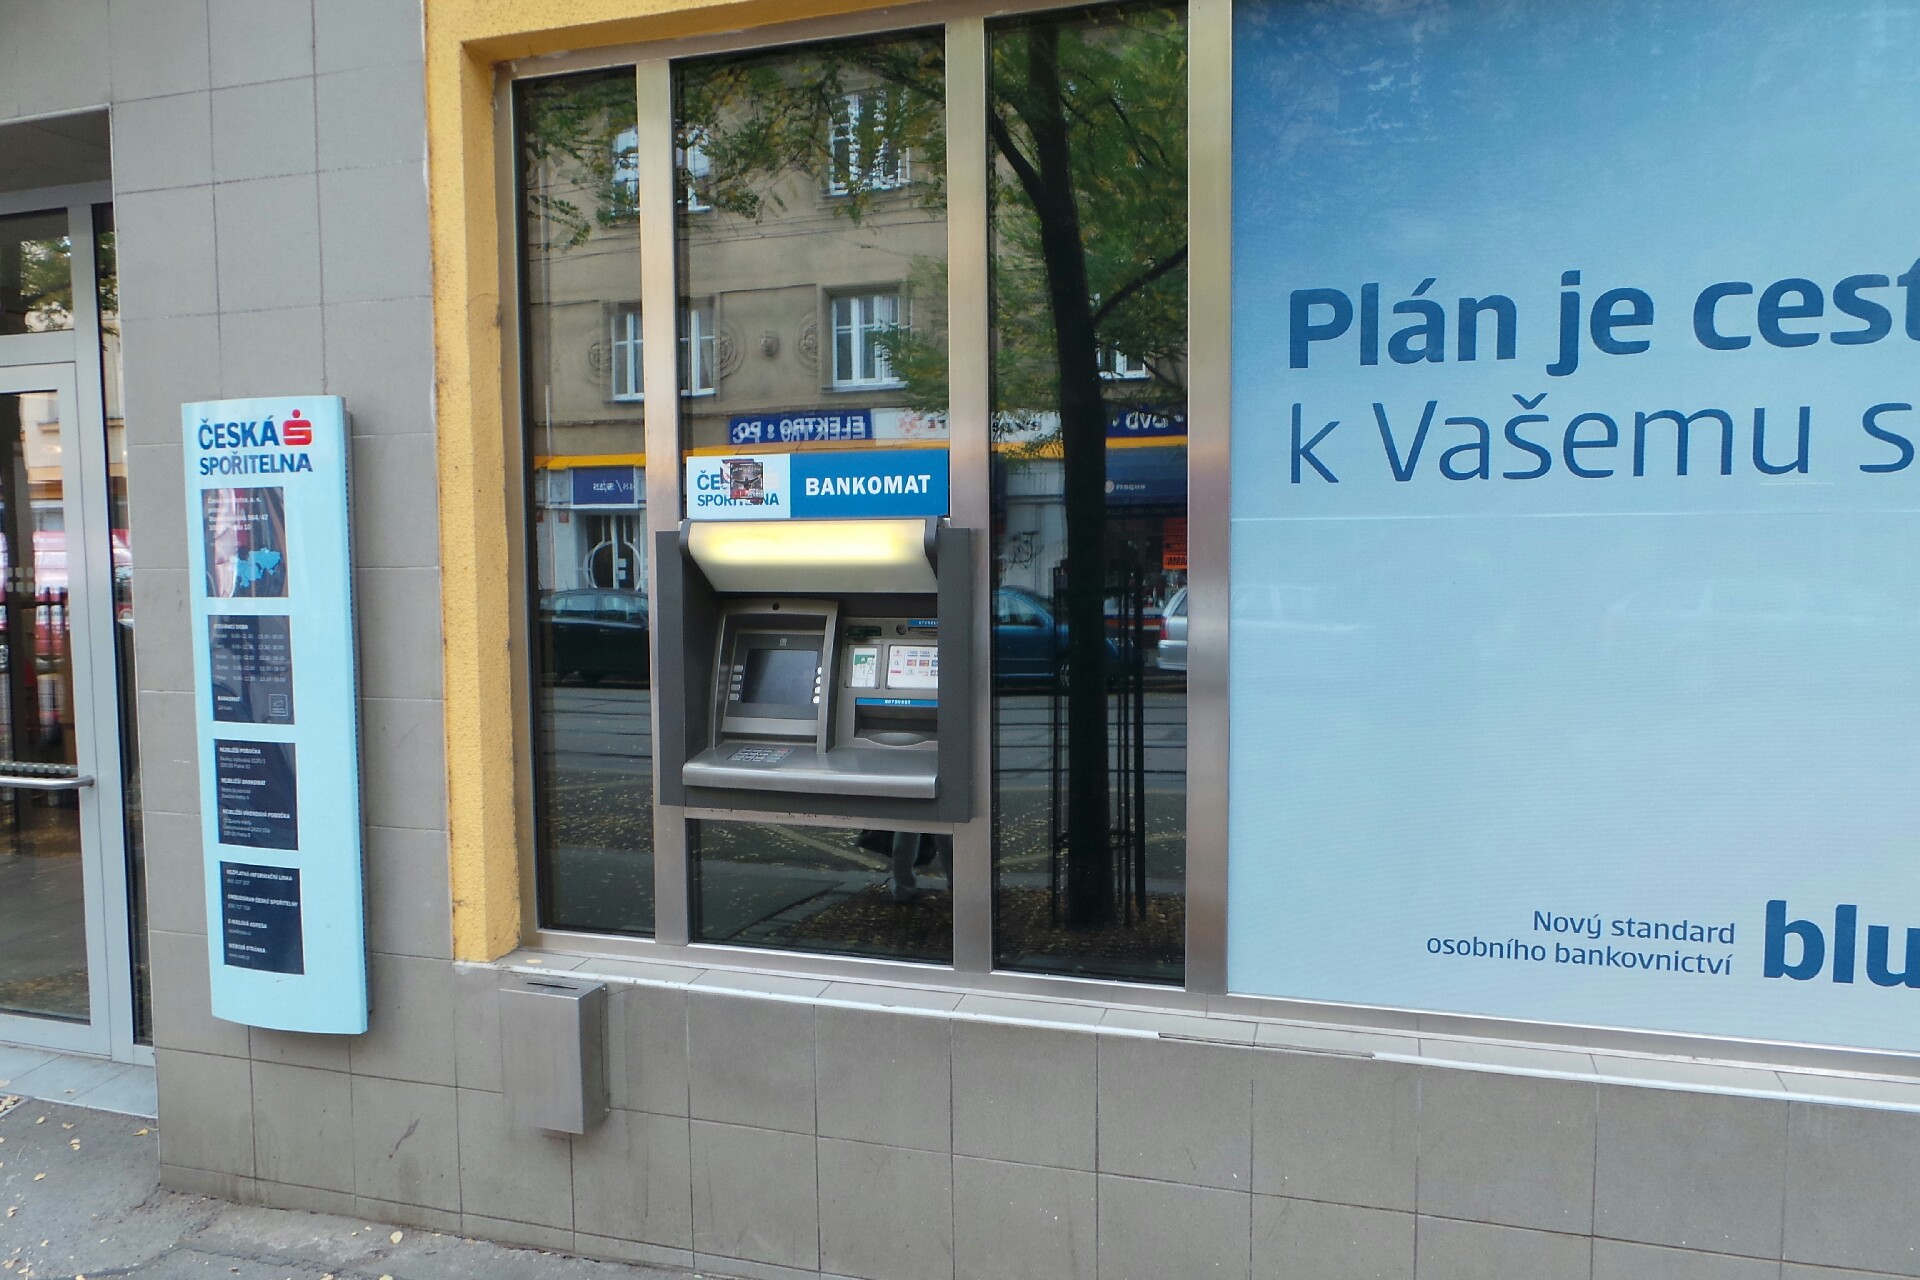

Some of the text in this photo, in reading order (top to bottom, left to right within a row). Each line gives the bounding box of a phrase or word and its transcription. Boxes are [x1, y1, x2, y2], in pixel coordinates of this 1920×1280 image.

[1289, 277, 1517, 369] Plán
[1546, 269, 1654, 376] je
[198, 414, 280, 450] ČESKÁ
[1291, 402, 1340, 484] k
[1372, 392, 1811, 482] Vašemu
[200, 451, 314, 477] SPOŘITELNA
[805, 474, 931, 496] BANKOMAT
[1532, 910, 1736, 945] Nový standard
[1426, 935, 1547, 963] osobního
[1555, 943, 1734, 976] bankovnictví
